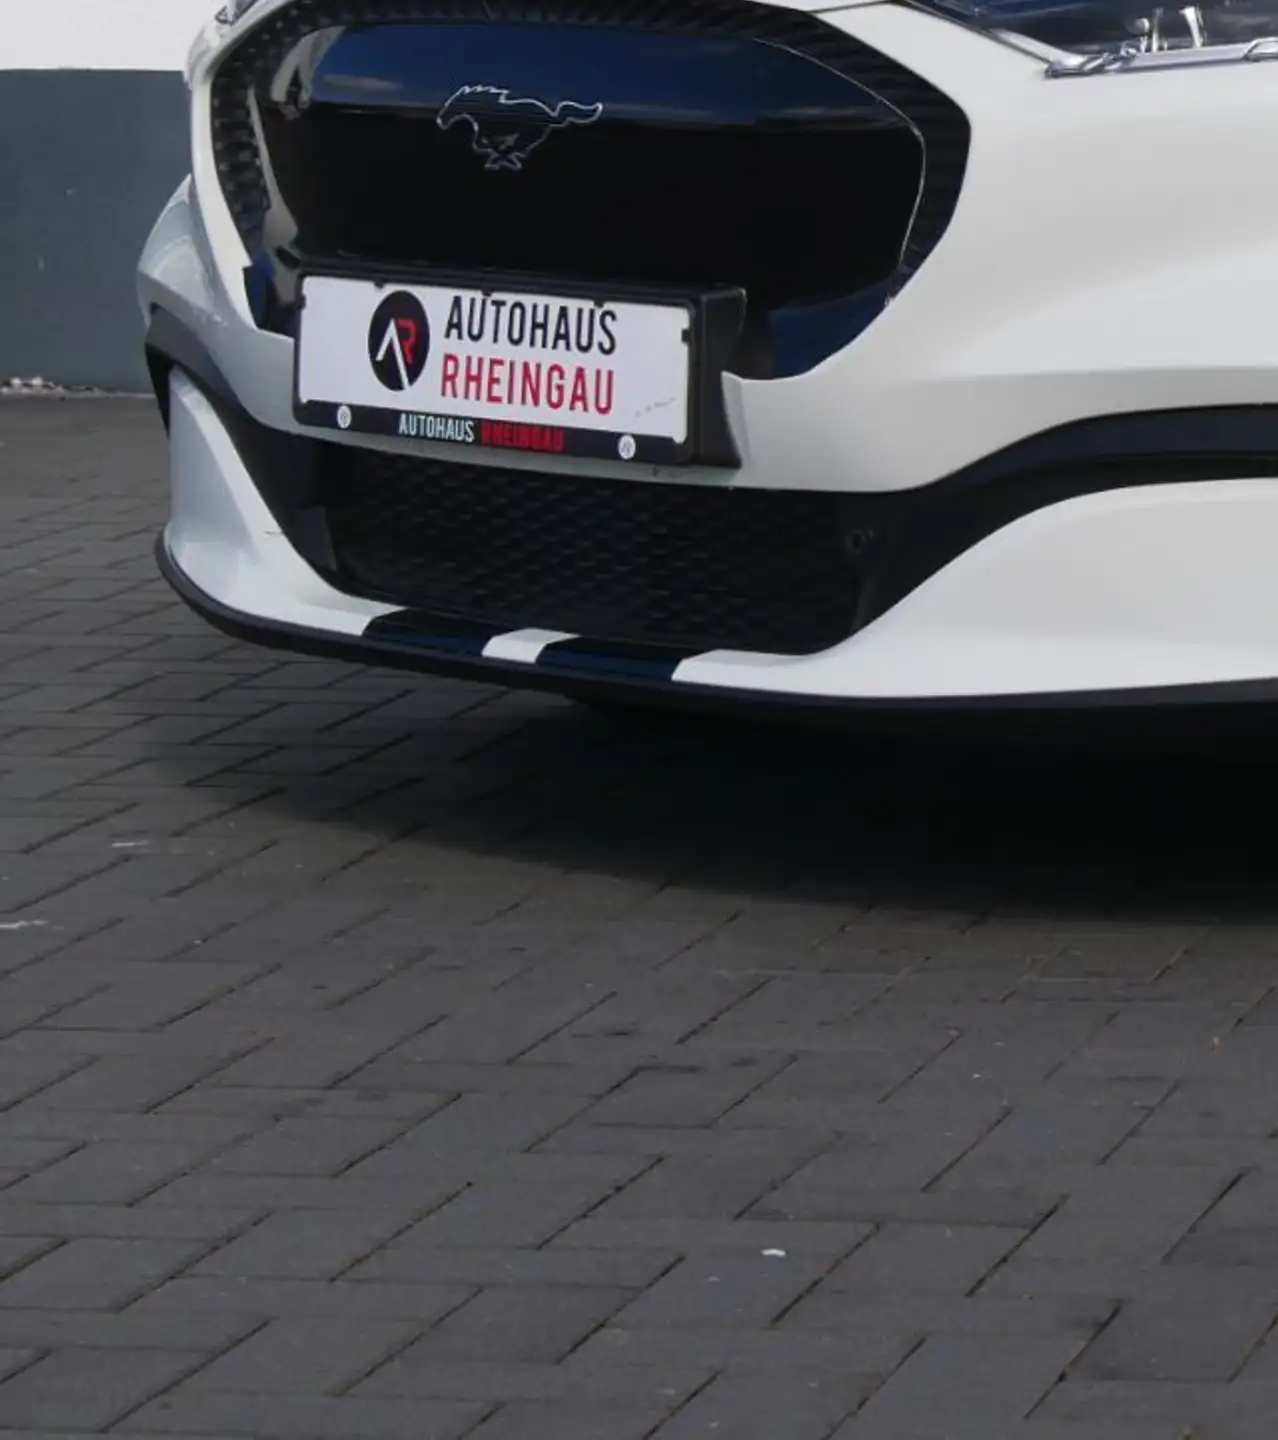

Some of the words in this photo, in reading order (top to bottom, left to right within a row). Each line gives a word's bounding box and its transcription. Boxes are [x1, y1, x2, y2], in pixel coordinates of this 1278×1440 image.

[444, 295, 617, 355] AUTOHAUS
[441, 353, 614, 414] RHEINGAU
[399, 413, 474, 442] AUTOHAUS
[481, 422, 564, 452] RHEINGAU
